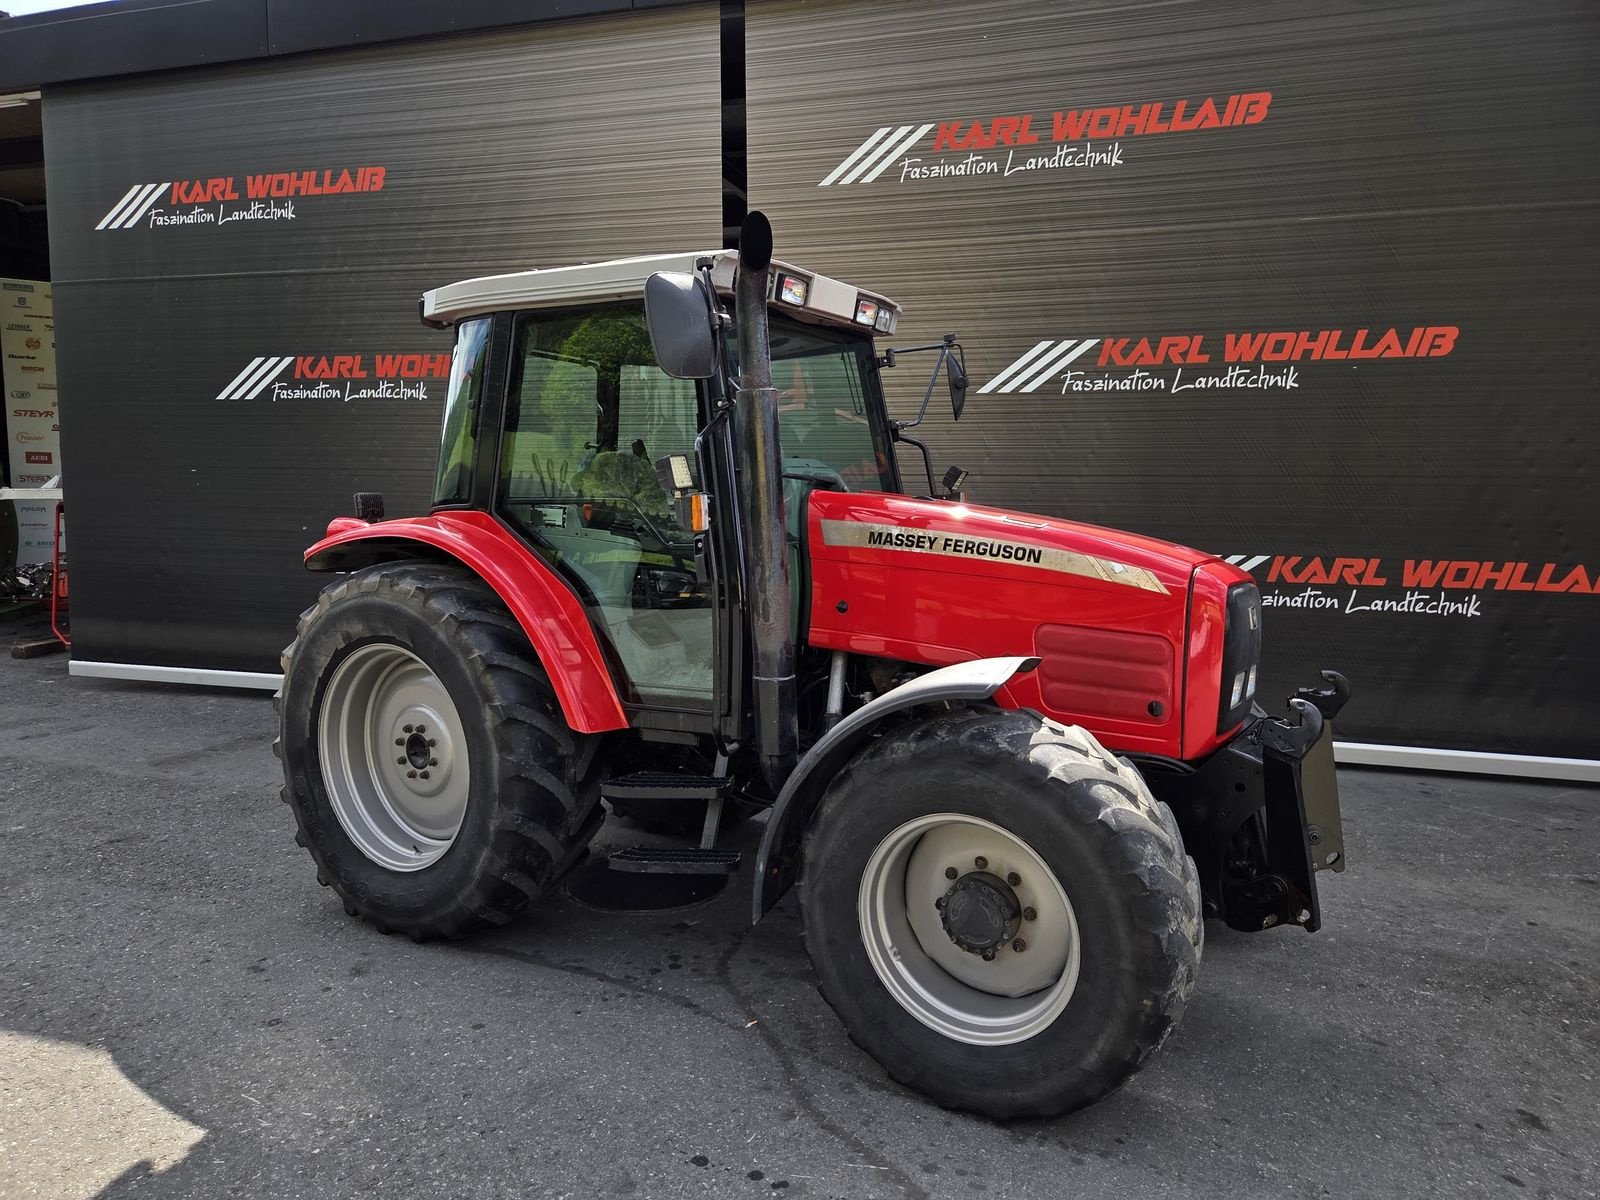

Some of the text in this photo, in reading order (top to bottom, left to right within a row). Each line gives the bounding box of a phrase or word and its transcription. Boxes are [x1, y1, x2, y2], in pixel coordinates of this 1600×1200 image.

[933, 114, 1039, 152] KARL
[899, 141, 1124, 183] Faszination Landtechnik
[171, 177, 240, 205] KARL
[148, 201, 296, 229] Faszination Landtechnik
[1097, 335, 1210, 367] KARL
[294, 355, 368, 379] KARL
[1060, 365, 1299, 396] Faszination Landtechnik
[272, 380, 428, 402] Faszination Landtechnik
[13, 409, 55, 418] STEYR
[867, 530, 1043, 564] MASSEY FERGUSON
[1267, 555, 1600, 594] KARL WOHLLA
[1261, 586, 1481, 617] zination Landtechnik
